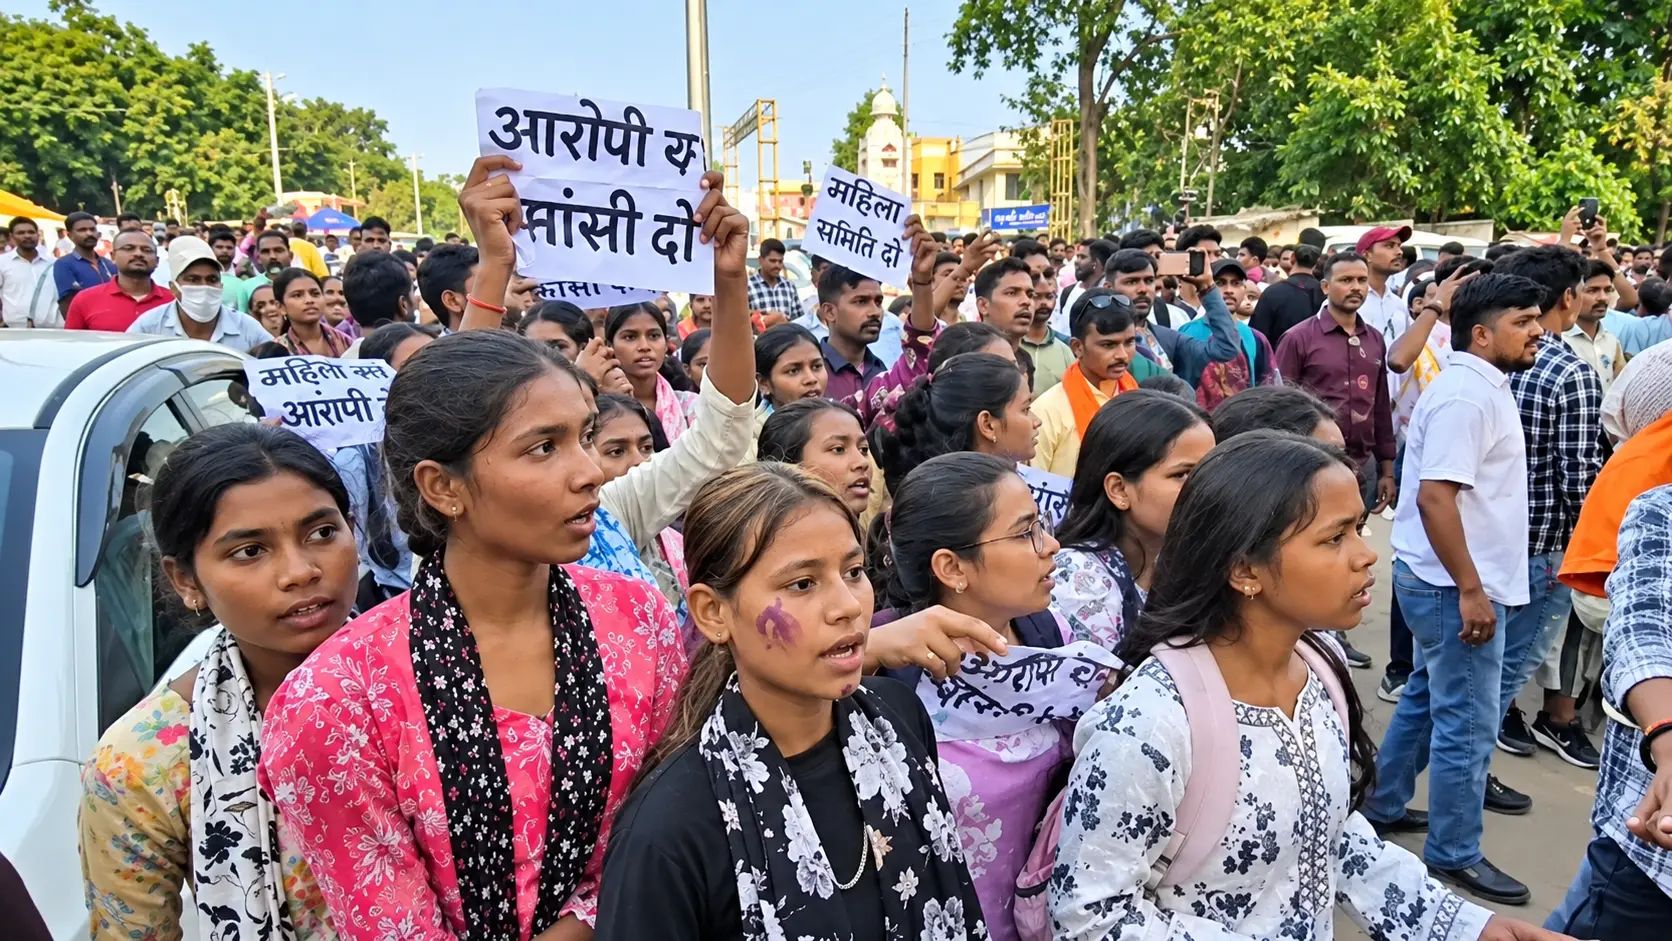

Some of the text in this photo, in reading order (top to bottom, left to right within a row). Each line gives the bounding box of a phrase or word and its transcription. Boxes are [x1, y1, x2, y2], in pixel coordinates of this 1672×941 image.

[488, 99, 654, 167] आरोपी
[827, 177, 905, 224] महिला
[652, 198, 702, 265] दो
[816, 218, 903, 268] समिति दो
